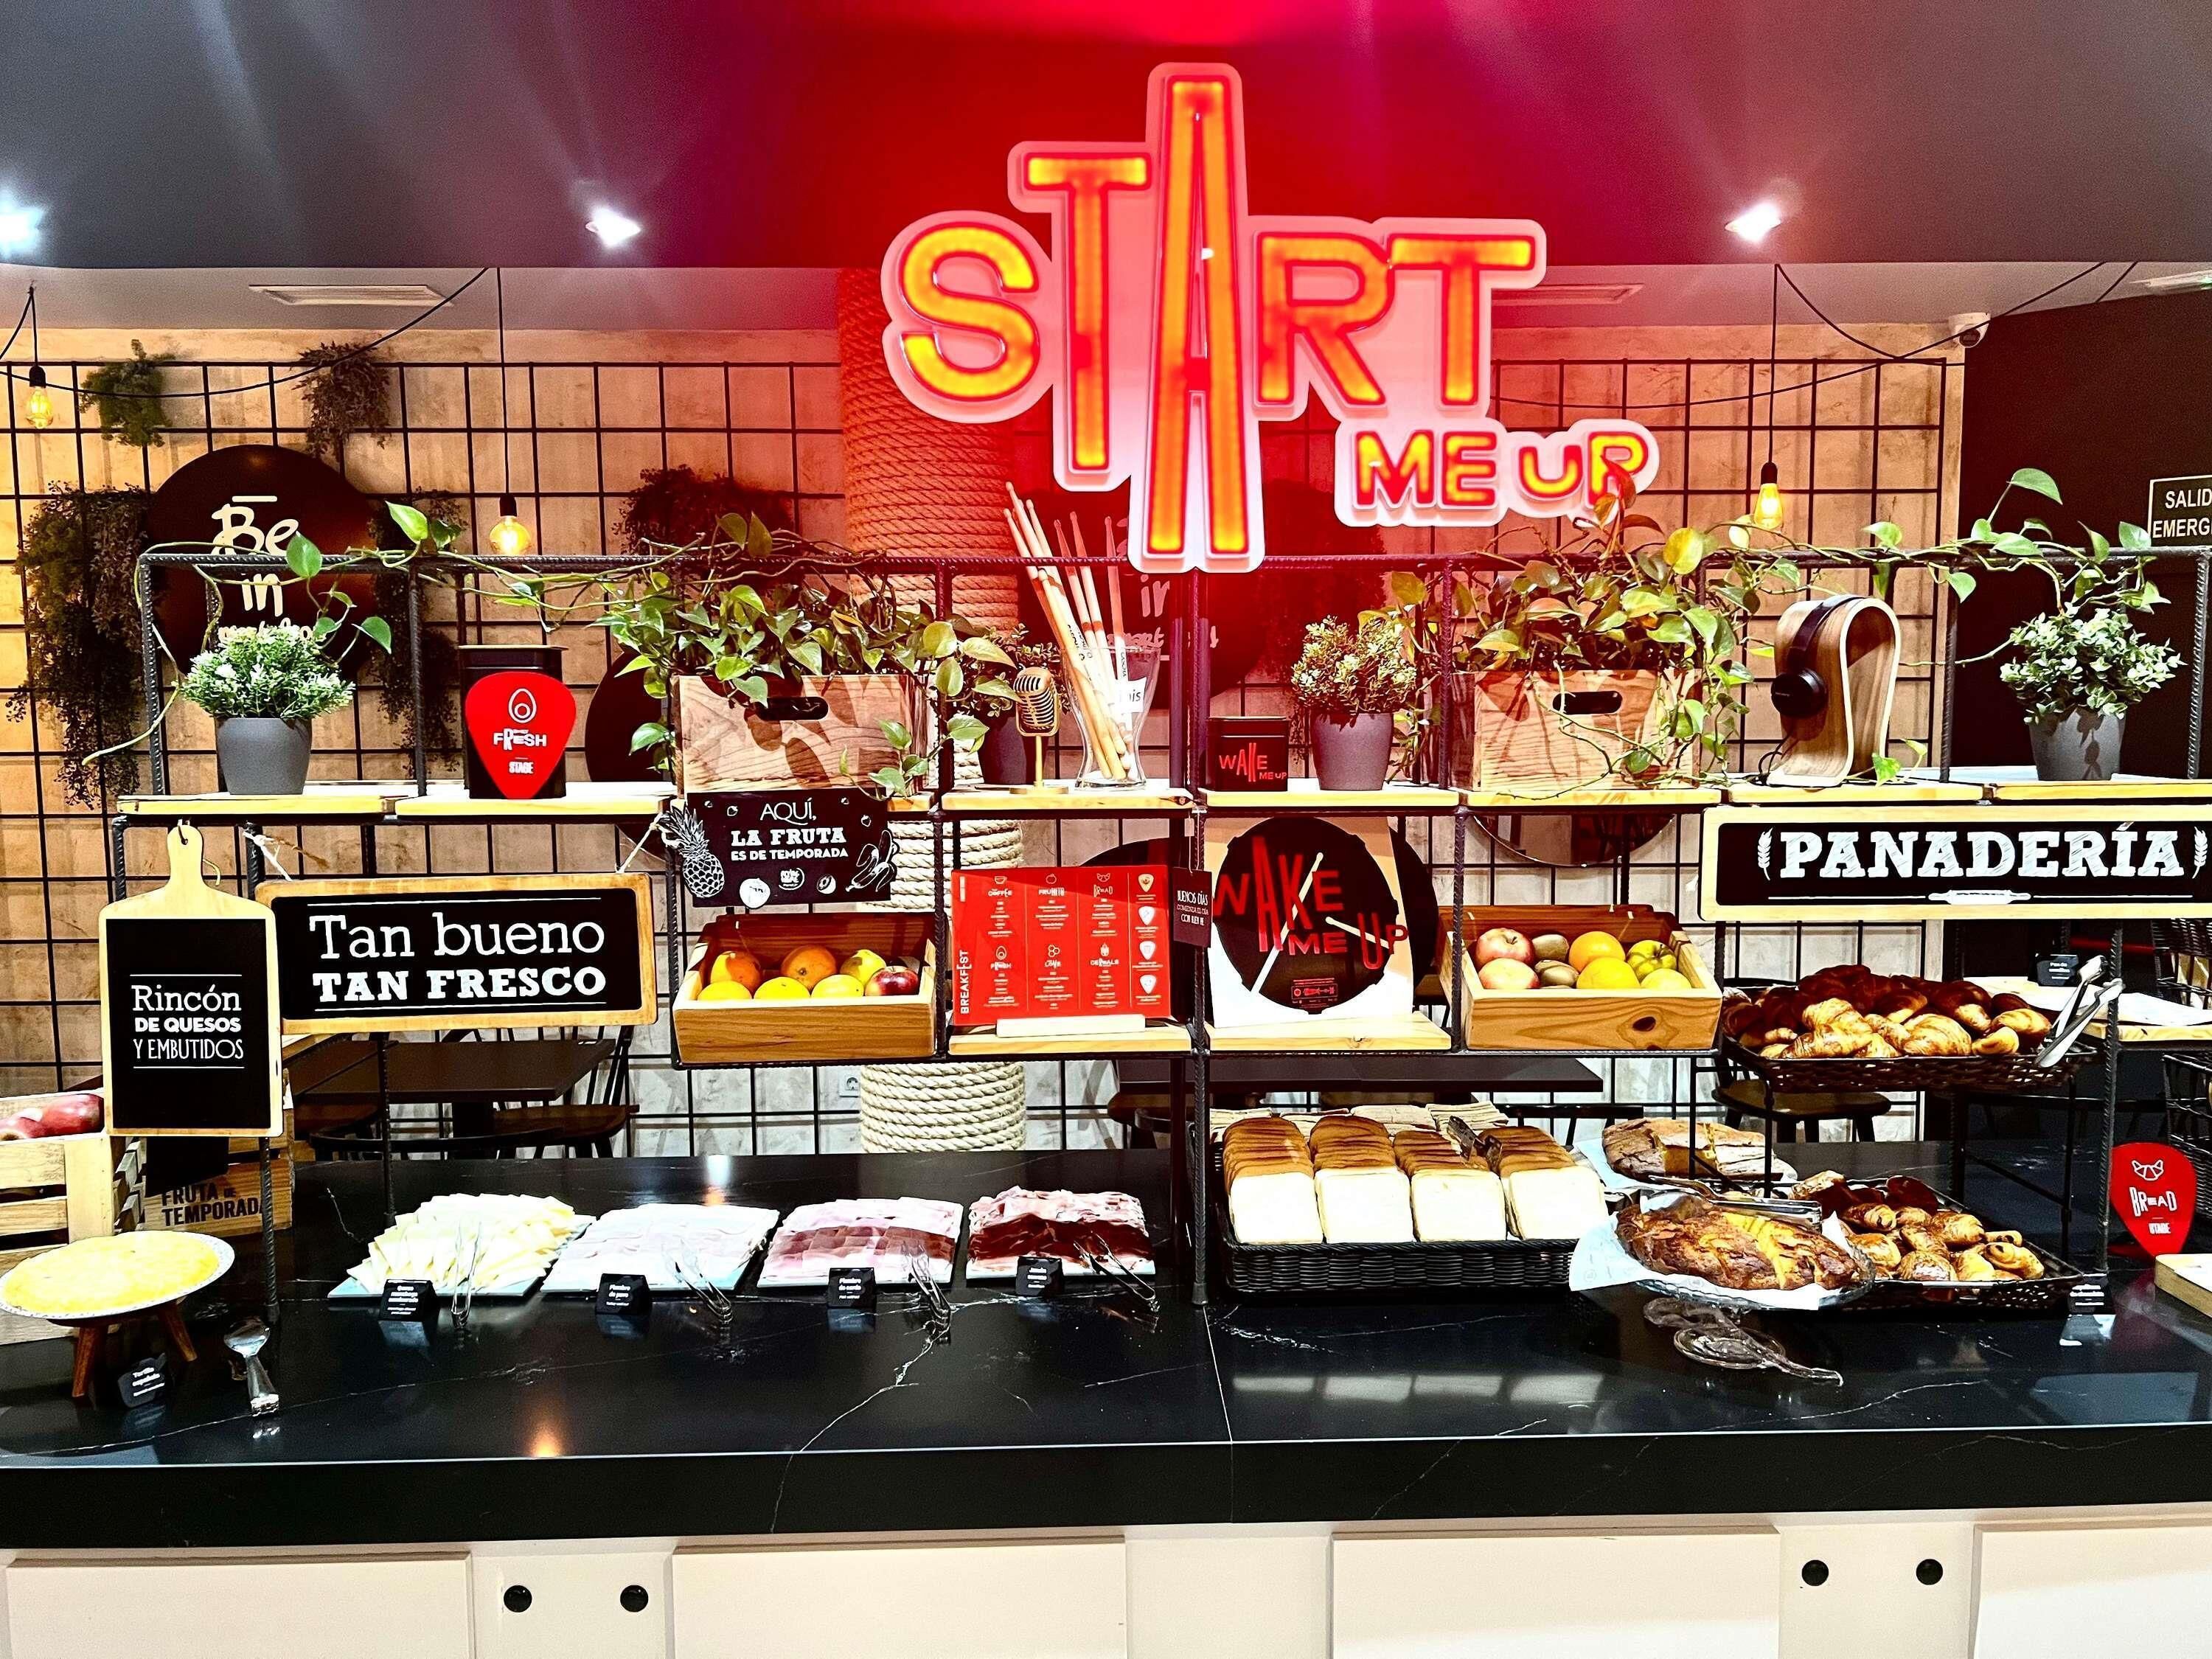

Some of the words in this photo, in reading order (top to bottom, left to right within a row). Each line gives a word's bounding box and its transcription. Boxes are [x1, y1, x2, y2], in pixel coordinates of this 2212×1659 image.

[895, 74, 1537, 556] START
[1355, 429, 1498, 507] ME
[1518, 431, 1649, 509] UP
[211, 503, 299, 556] Be
[2152, 517, 2212, 538] EMERG
[493, 728, 547, 751] FRESH
[509, 761, 534, 773] STAGE
[1219, 742, 1267, 782] WAKE
[759, 797, 817, 825] AQUÍ,
[731, 830, 762, 846] LA
[770, 827, 847, 846] FRUTA
[1779, 821, 2185, 879] PANADERÍA
[731, 850, 747, 861] ES
[750, 849, 767, 860] DE
[769, 848, 849, 860] TEMPORADA
[1093, 884, 1113, 897] BREAD
[1212, 835, 1344, 953] WAKE
[309, 914, 415, 959] Tan
[432, 911, 605, 956] bueno
[1288, 931, 1348, 956] ME
[1357, 912, 1409, 970] UP
[131, 984, 242, 1012] Rincón
[312, 970, 409, 1002] TAN
[425, 966, 607, 999] FRESCO
[134, 1017, 160, 1032] DE
[164, 1017, 242, 1033] QUESOS
[133, 1038, 144, 1059] Y
[147, 1038, 244, 1060] EMBUTIDOS
[161, 1182, 219, 1206] FRUTA
[223, 1187, 237, 1198] DE
[2129, 1186, 2177, 1217] BREAD
[161, 1197, 263, 1226] TEMPORAD
